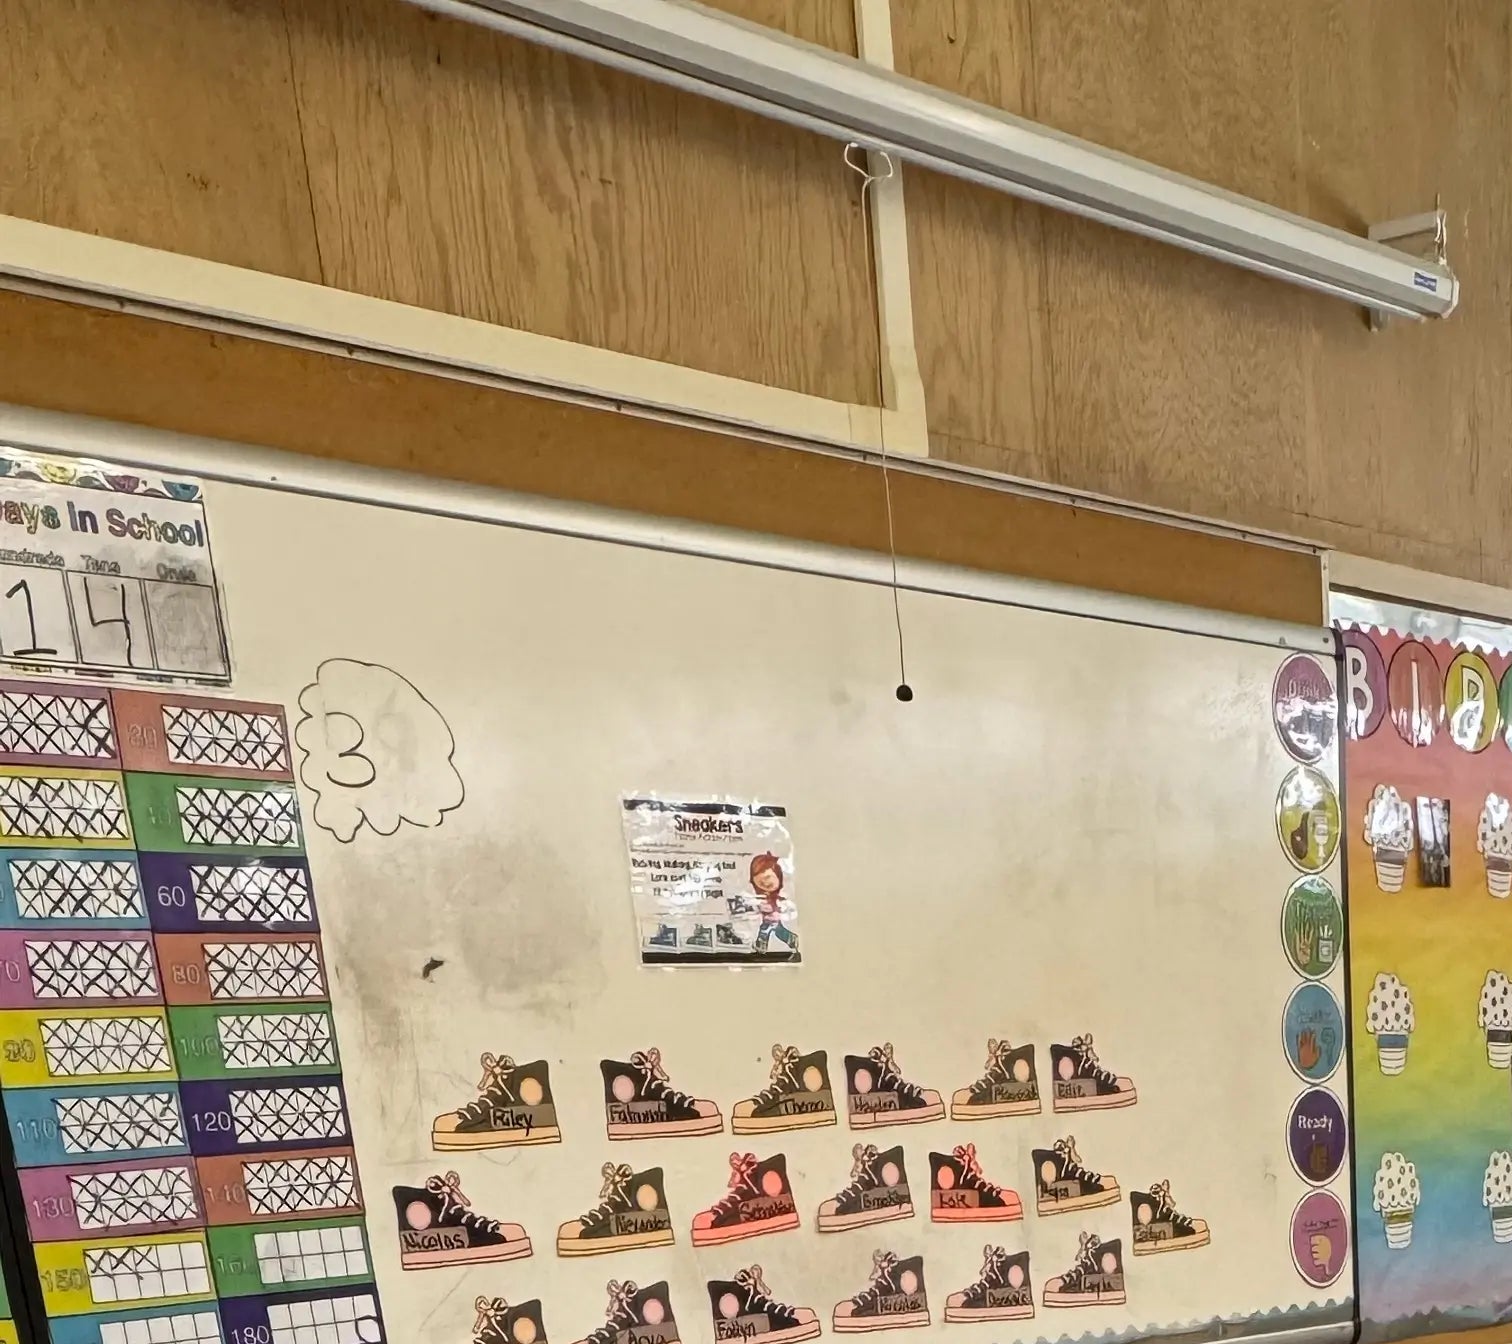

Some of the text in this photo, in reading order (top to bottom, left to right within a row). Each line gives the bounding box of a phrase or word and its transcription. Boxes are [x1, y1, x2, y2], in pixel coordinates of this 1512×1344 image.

[0, 500, 61, 534] ays
[106, 508, 204, 547] School
[6, 576, 134, 667] 1 4
[324, 711, 377, 788] 3
[674, 814, 744, 834] Sneakers
[157, 885, 186, 907] 60
[16, 1120, 58, 1142] 110
[191, 1111, 232, 1133] 120
[1298, 1115, 1333, 1134] Ready
[32, 1198, 74, 1218] 130
[403, 1231, 465, 1252] Nicolas
